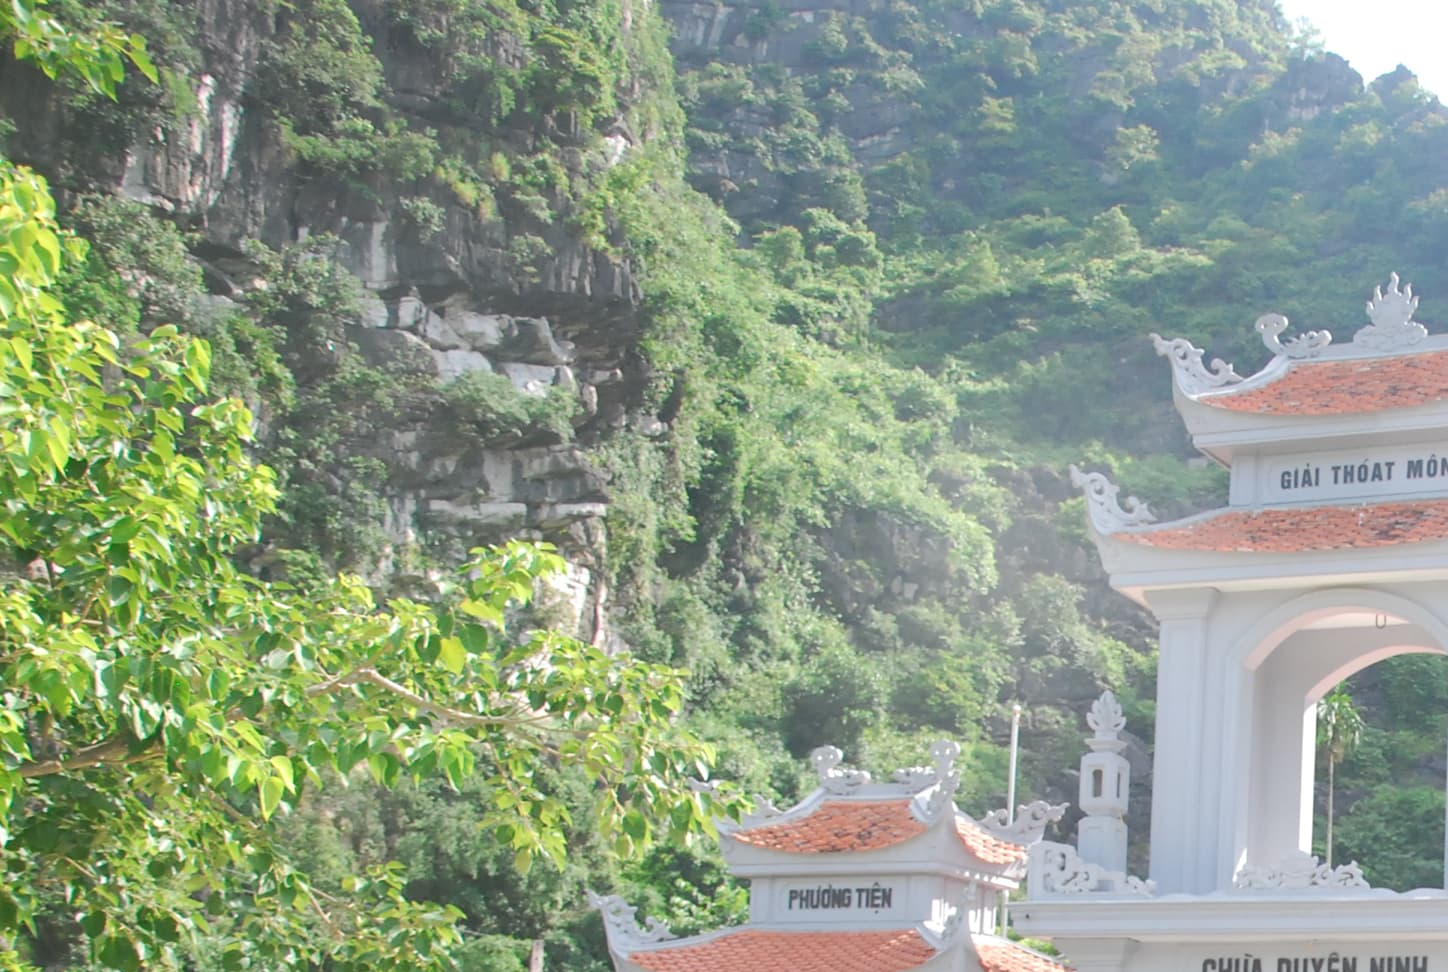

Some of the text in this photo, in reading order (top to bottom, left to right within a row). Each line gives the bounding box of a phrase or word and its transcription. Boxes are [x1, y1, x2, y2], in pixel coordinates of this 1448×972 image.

[1331, 459, 1395, 485] THÓAT
[788, 881, 892, 914] PHƯƠNG TIỆN
